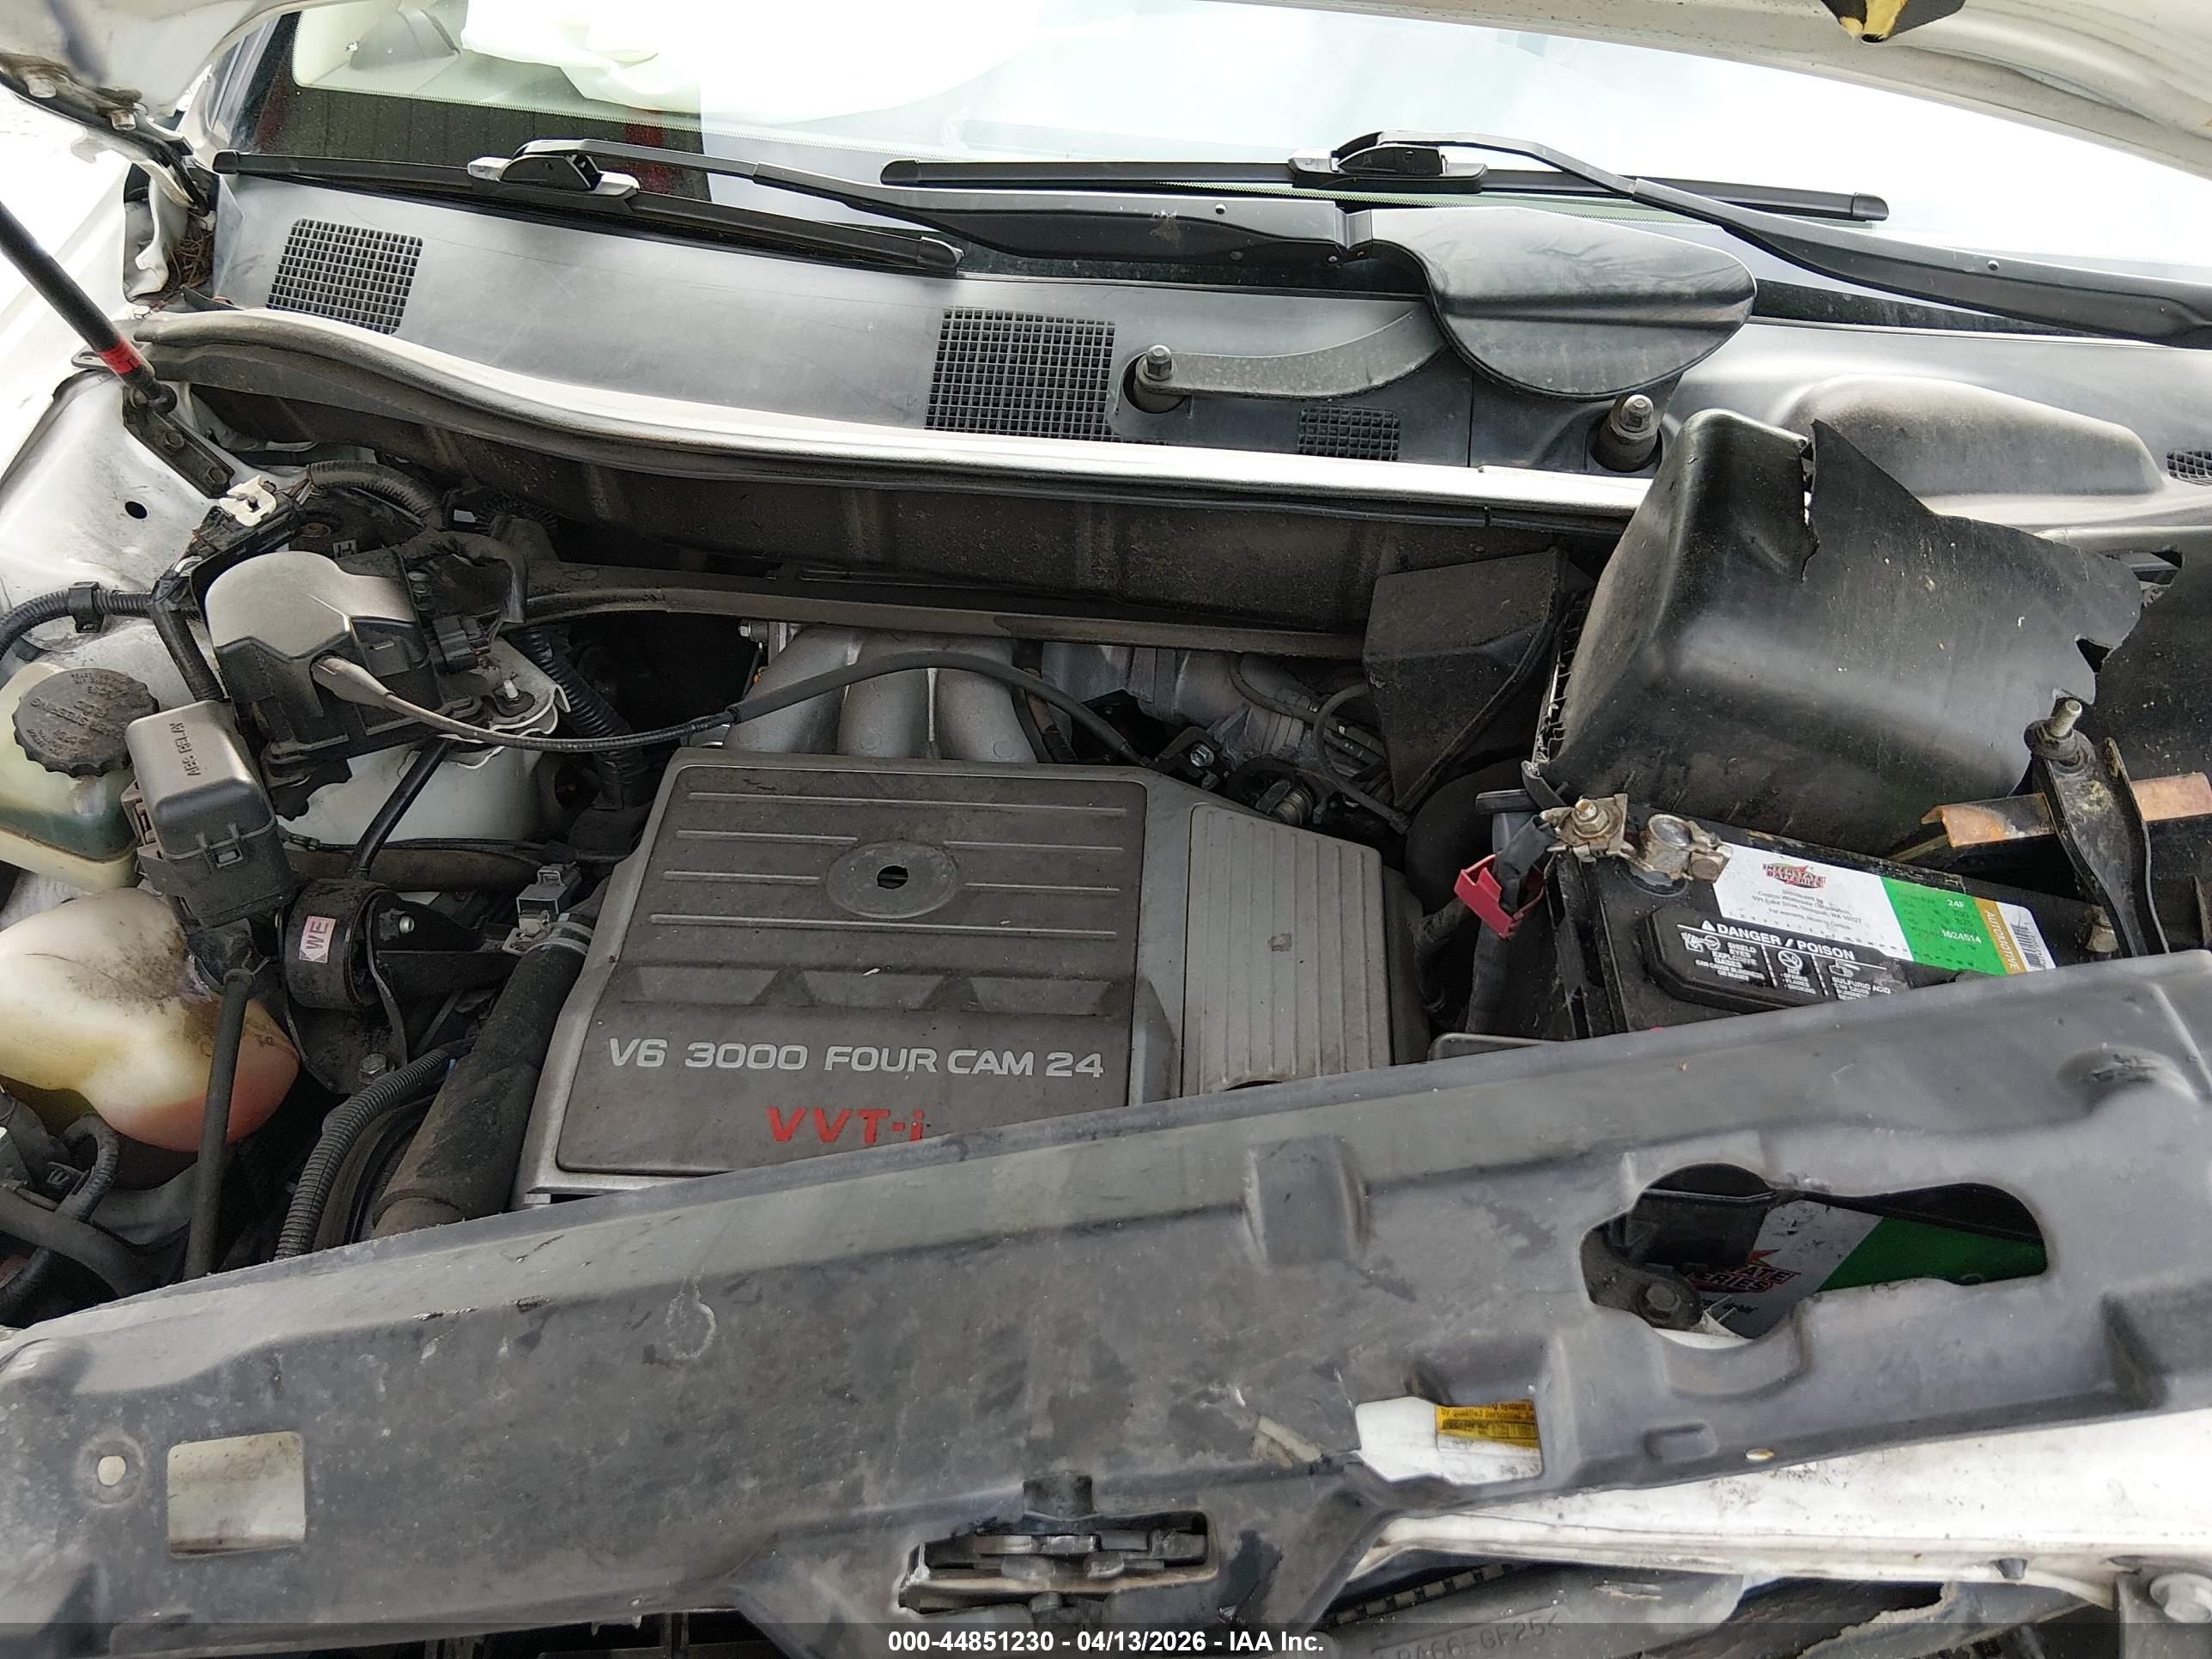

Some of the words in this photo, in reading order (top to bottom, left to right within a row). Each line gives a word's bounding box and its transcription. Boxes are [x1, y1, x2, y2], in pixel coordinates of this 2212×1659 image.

[1762, 863, 1826, 883] INTERSTATE
[1765, 870, 1825, 888] BATTERIES
[1946, 899, 1966, 908] 24F
[306, 921, 330, 950] WE
[1717, 923, 1782, 945] DANGER
[1796, 939, 1856, 961] POISON
[1984, 910, 2021, 970] AUTOMOTIVE
[1727, 941, 1758, 954] SHIELD
[1729, 948, 1752, 958] EYES
[1711, 950, 1759, 966] EXPLOSIVE
[1713, 957, 1744, 969] GASES
[1832, 975, 1872, 991] SULFURIC
[1872, 985, 1891, 994] ACID
[609, 1037, 668, 1067] V6
[684, 1042, 809, 1070] 3000
[823, 1045, 938, 1073] FOUR
[947, 1048, 1035, 1076] CAM
[1045, 1051, 1104, 1078] 24
[766, 1106, 925, 1146] VVT-i
